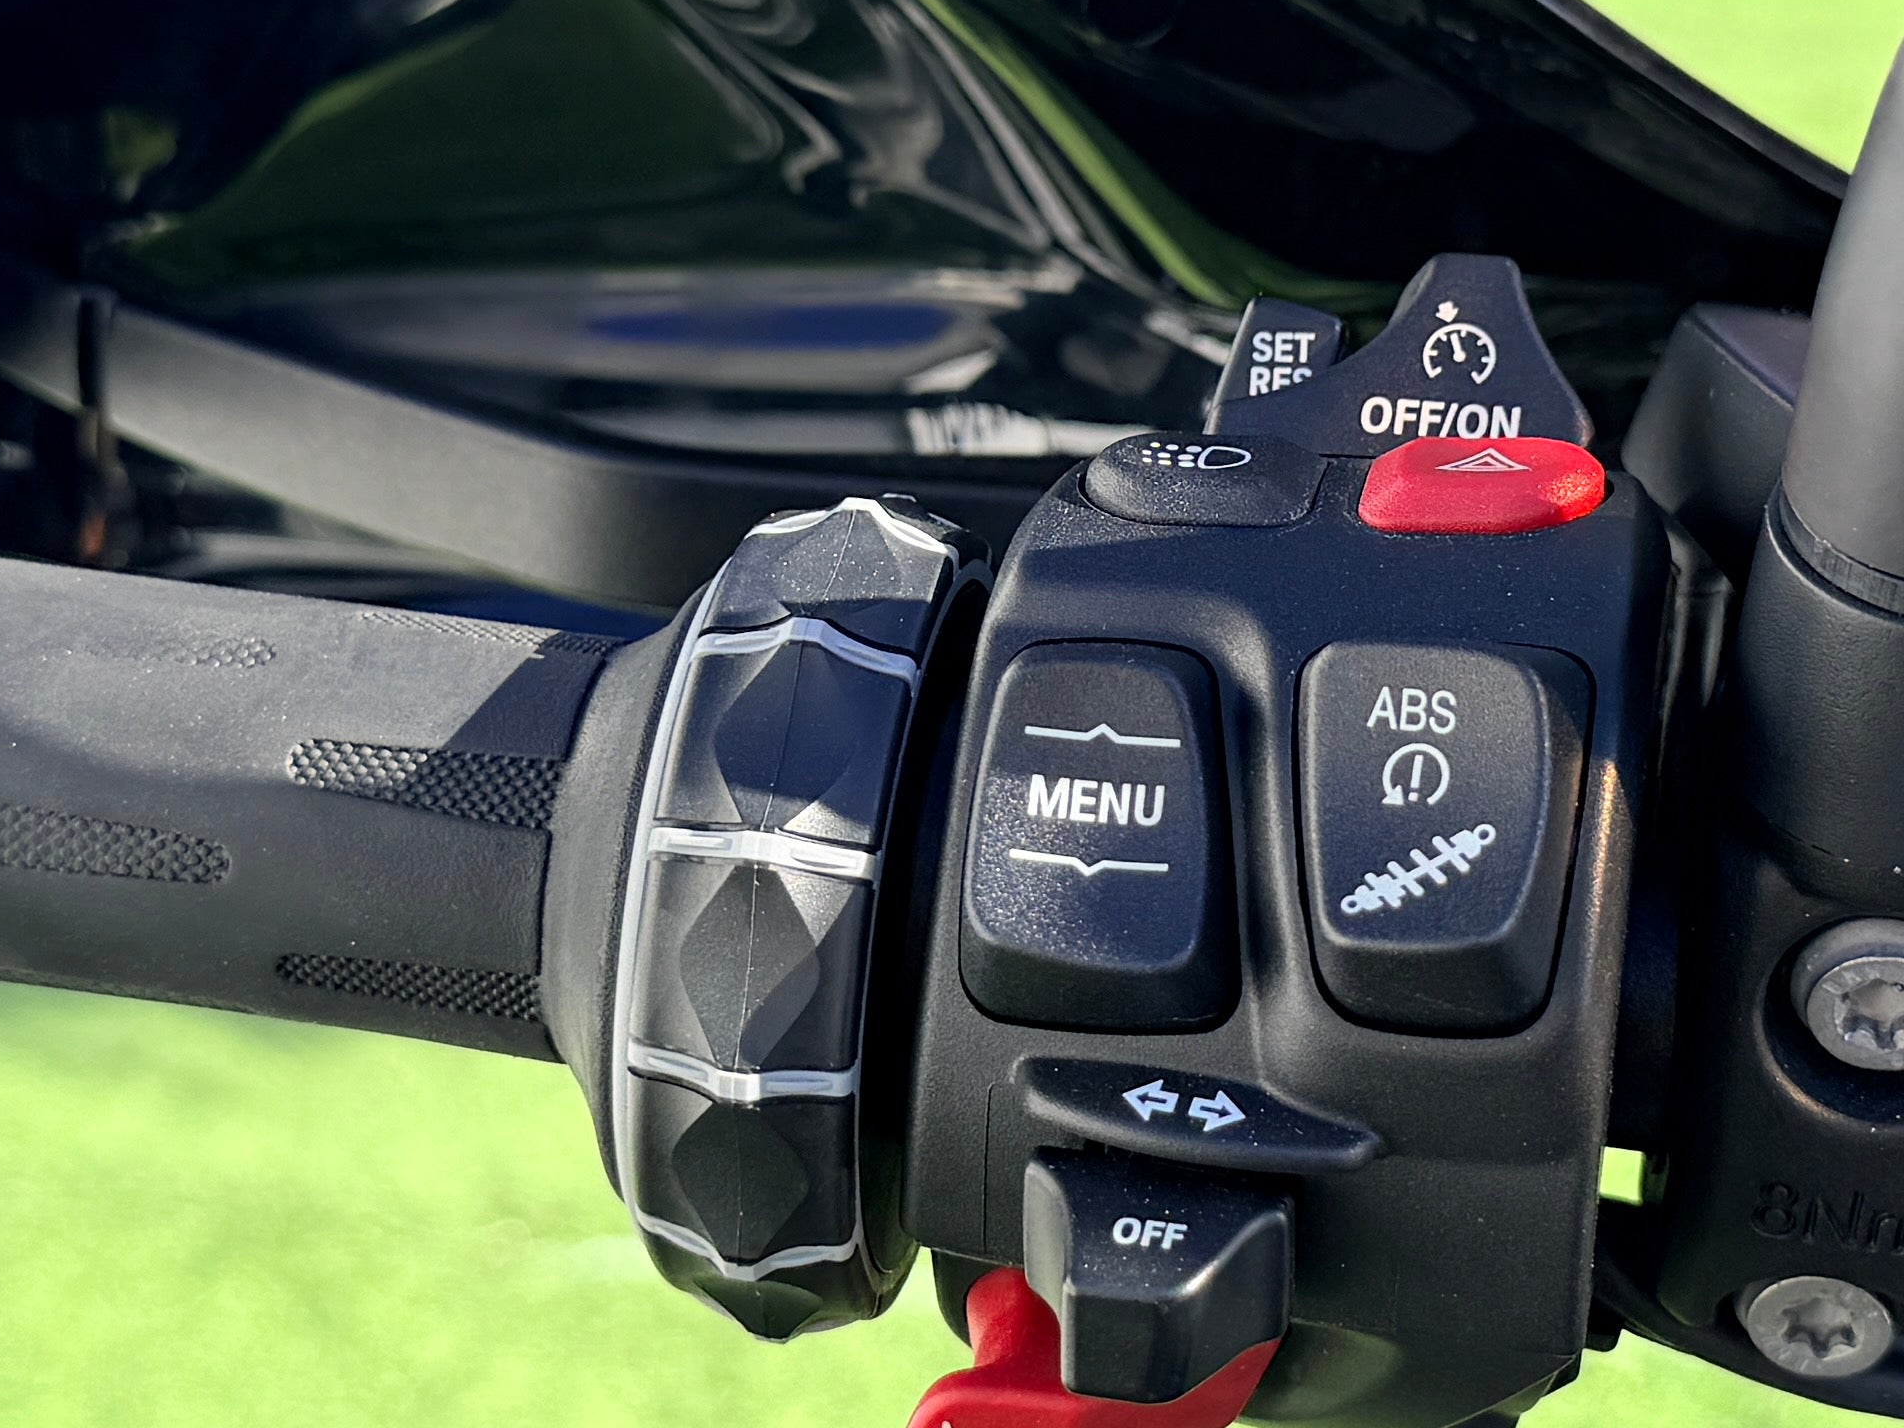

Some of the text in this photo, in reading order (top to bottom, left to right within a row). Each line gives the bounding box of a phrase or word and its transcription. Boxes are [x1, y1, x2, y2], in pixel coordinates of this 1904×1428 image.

[1251, 331, 1316, 364] SET
[1360, 396, 1522, 439] OFF/ON
[1366, 686, 1458, 735] ABS
[1027, 773, 1166, 827] MENU
[1112, 1216, 1188, 1250] OFF
